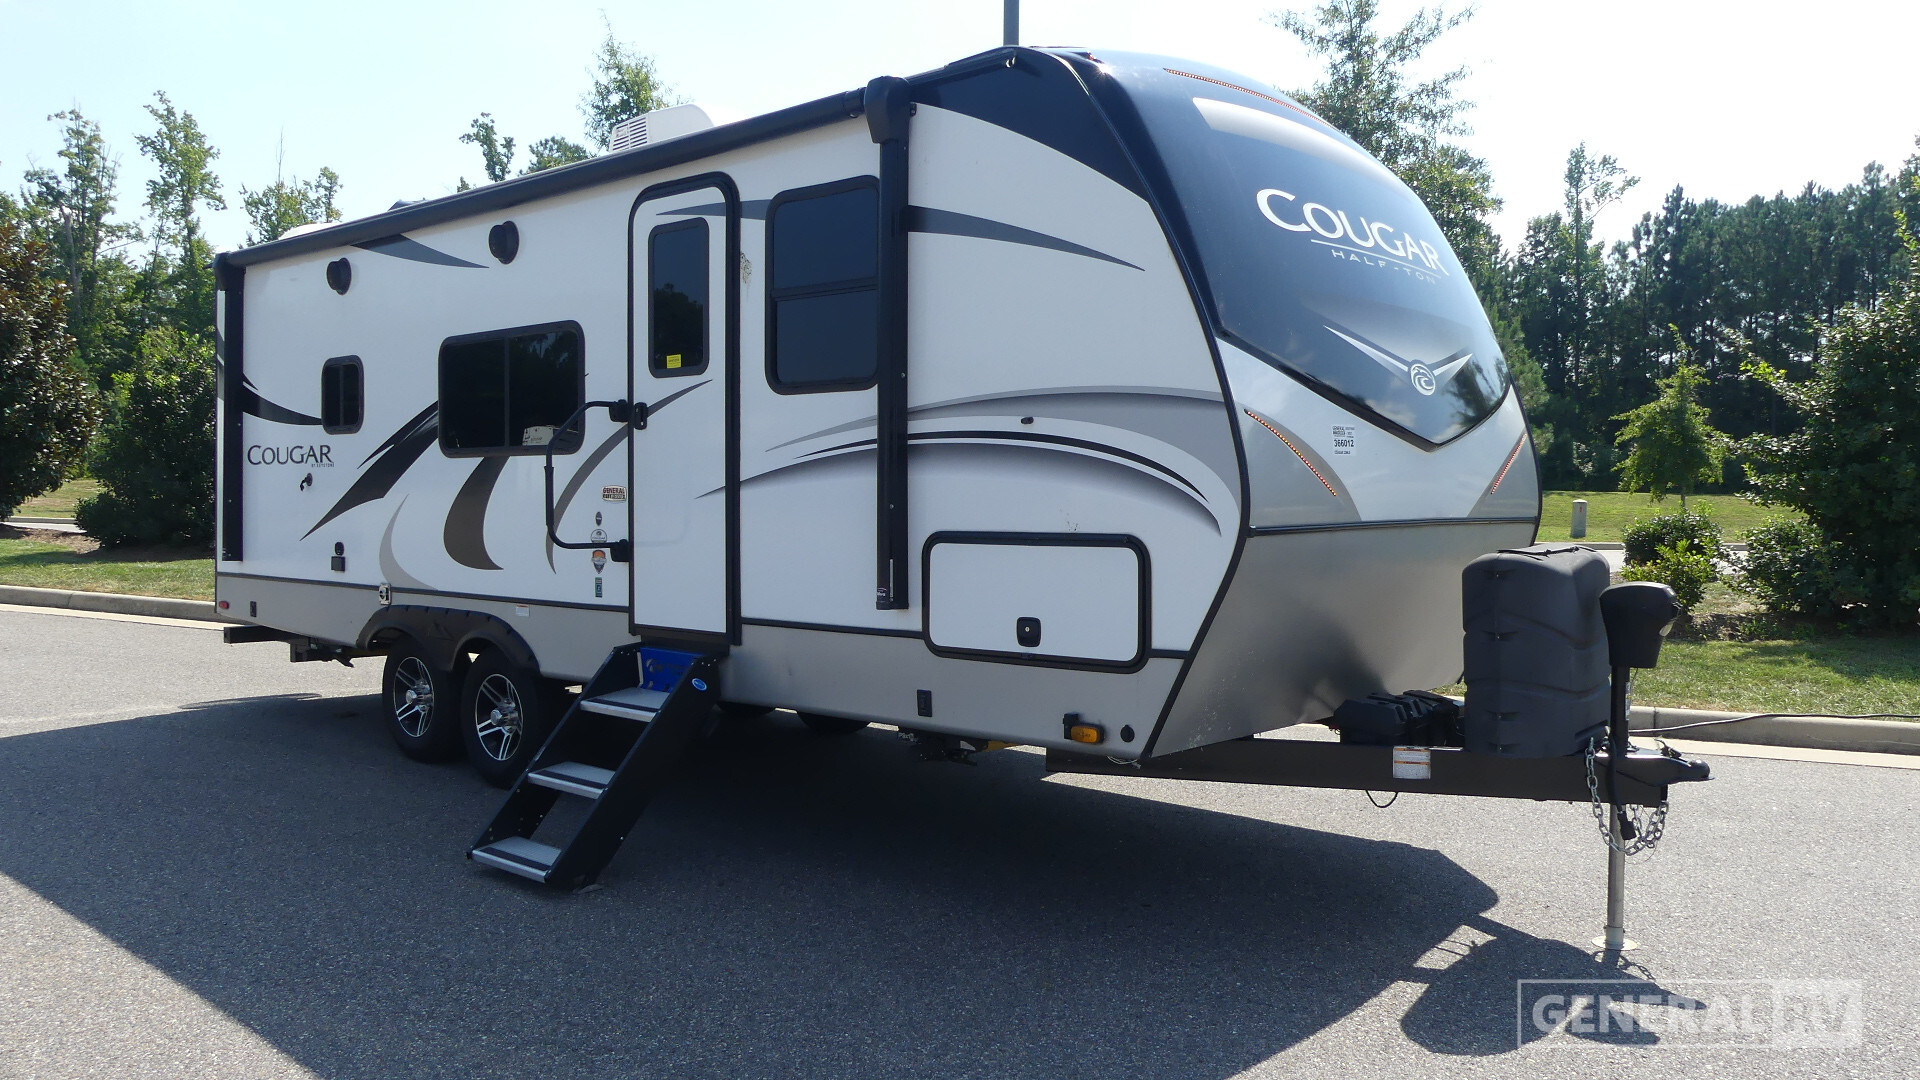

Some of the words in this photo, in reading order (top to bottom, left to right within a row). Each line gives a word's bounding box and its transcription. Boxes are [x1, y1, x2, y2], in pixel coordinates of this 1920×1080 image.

[1256, 188, 1449, 276] COUGAR
[1333, 439, 1355, 448] 366012
[247, 444, 334, 466] COUGAR
